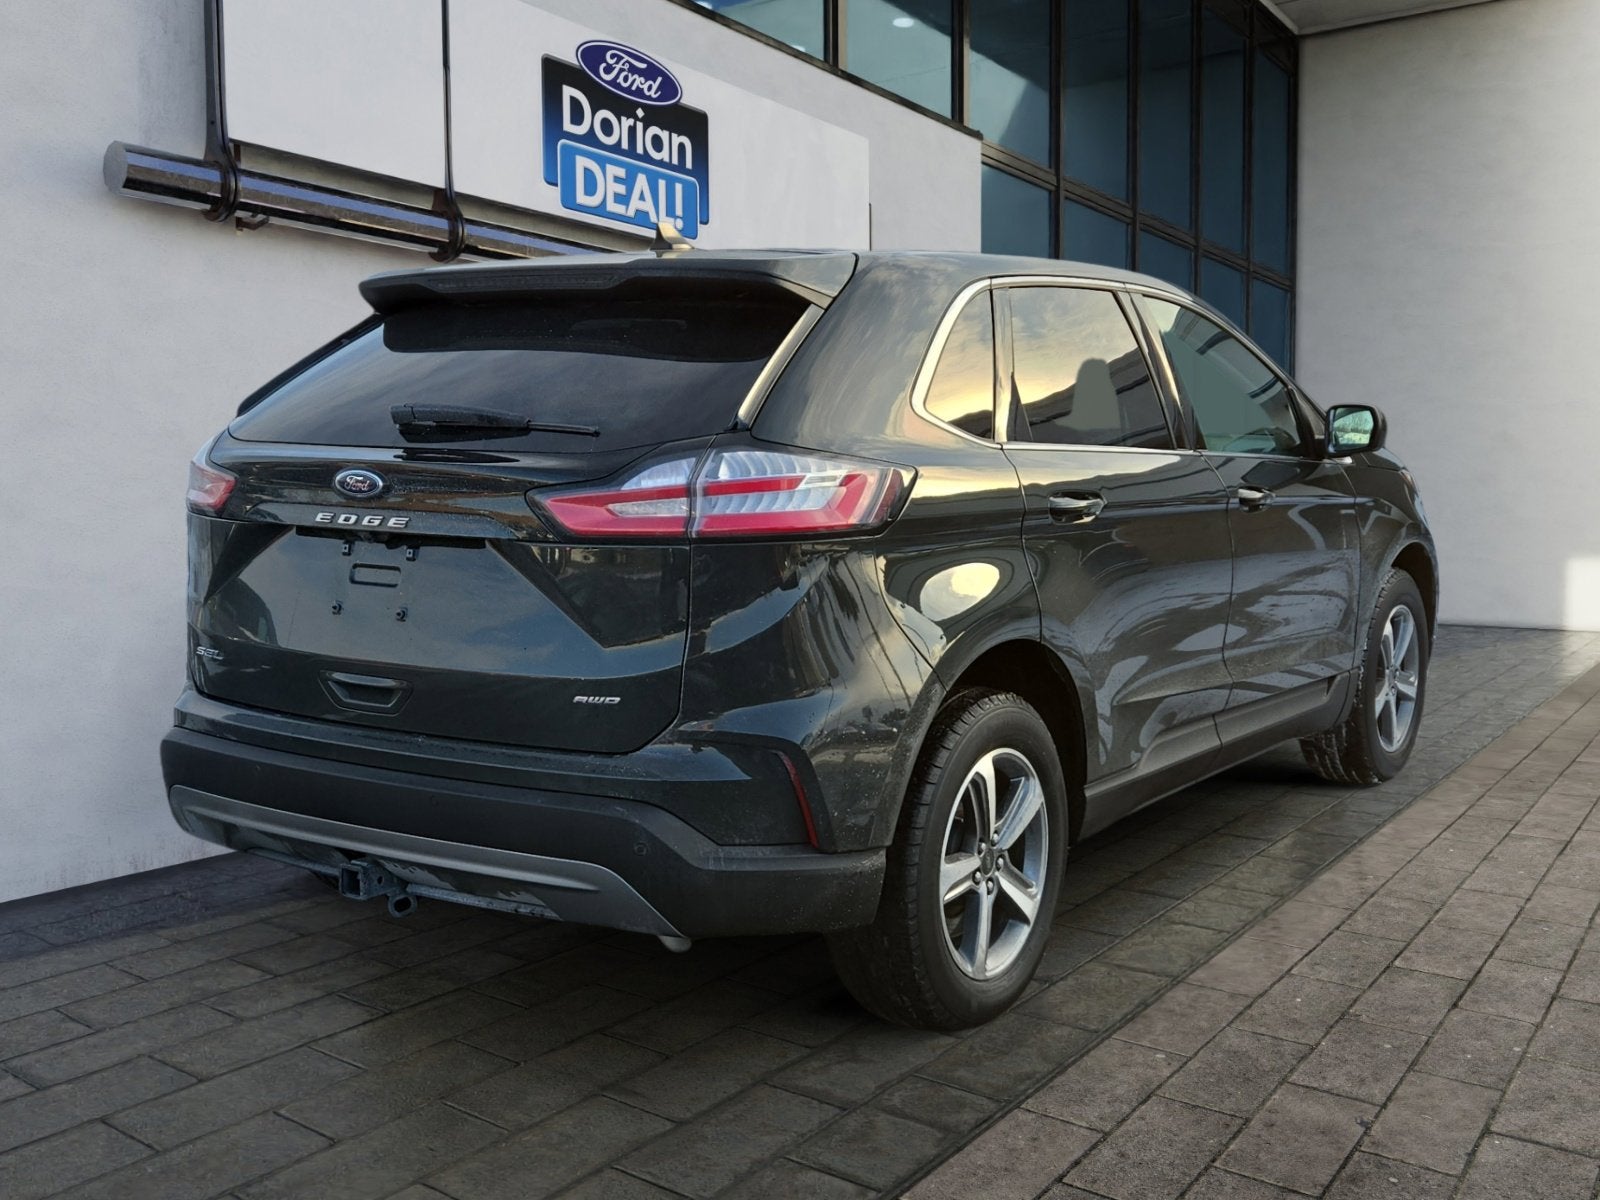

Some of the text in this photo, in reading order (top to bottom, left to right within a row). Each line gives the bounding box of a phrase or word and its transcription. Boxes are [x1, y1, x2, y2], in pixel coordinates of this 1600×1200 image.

[599, 50, 662, 99] Ford
[562, 84, 693, 170] Dorian
[575, 155, 683, 231] DEAL!
[344, 475, 370, 491] Ford
[315, 512, 410, 528] EDGE
[196, 646, 224, 660] SEL
[573, 695, 621, 705] AWD
